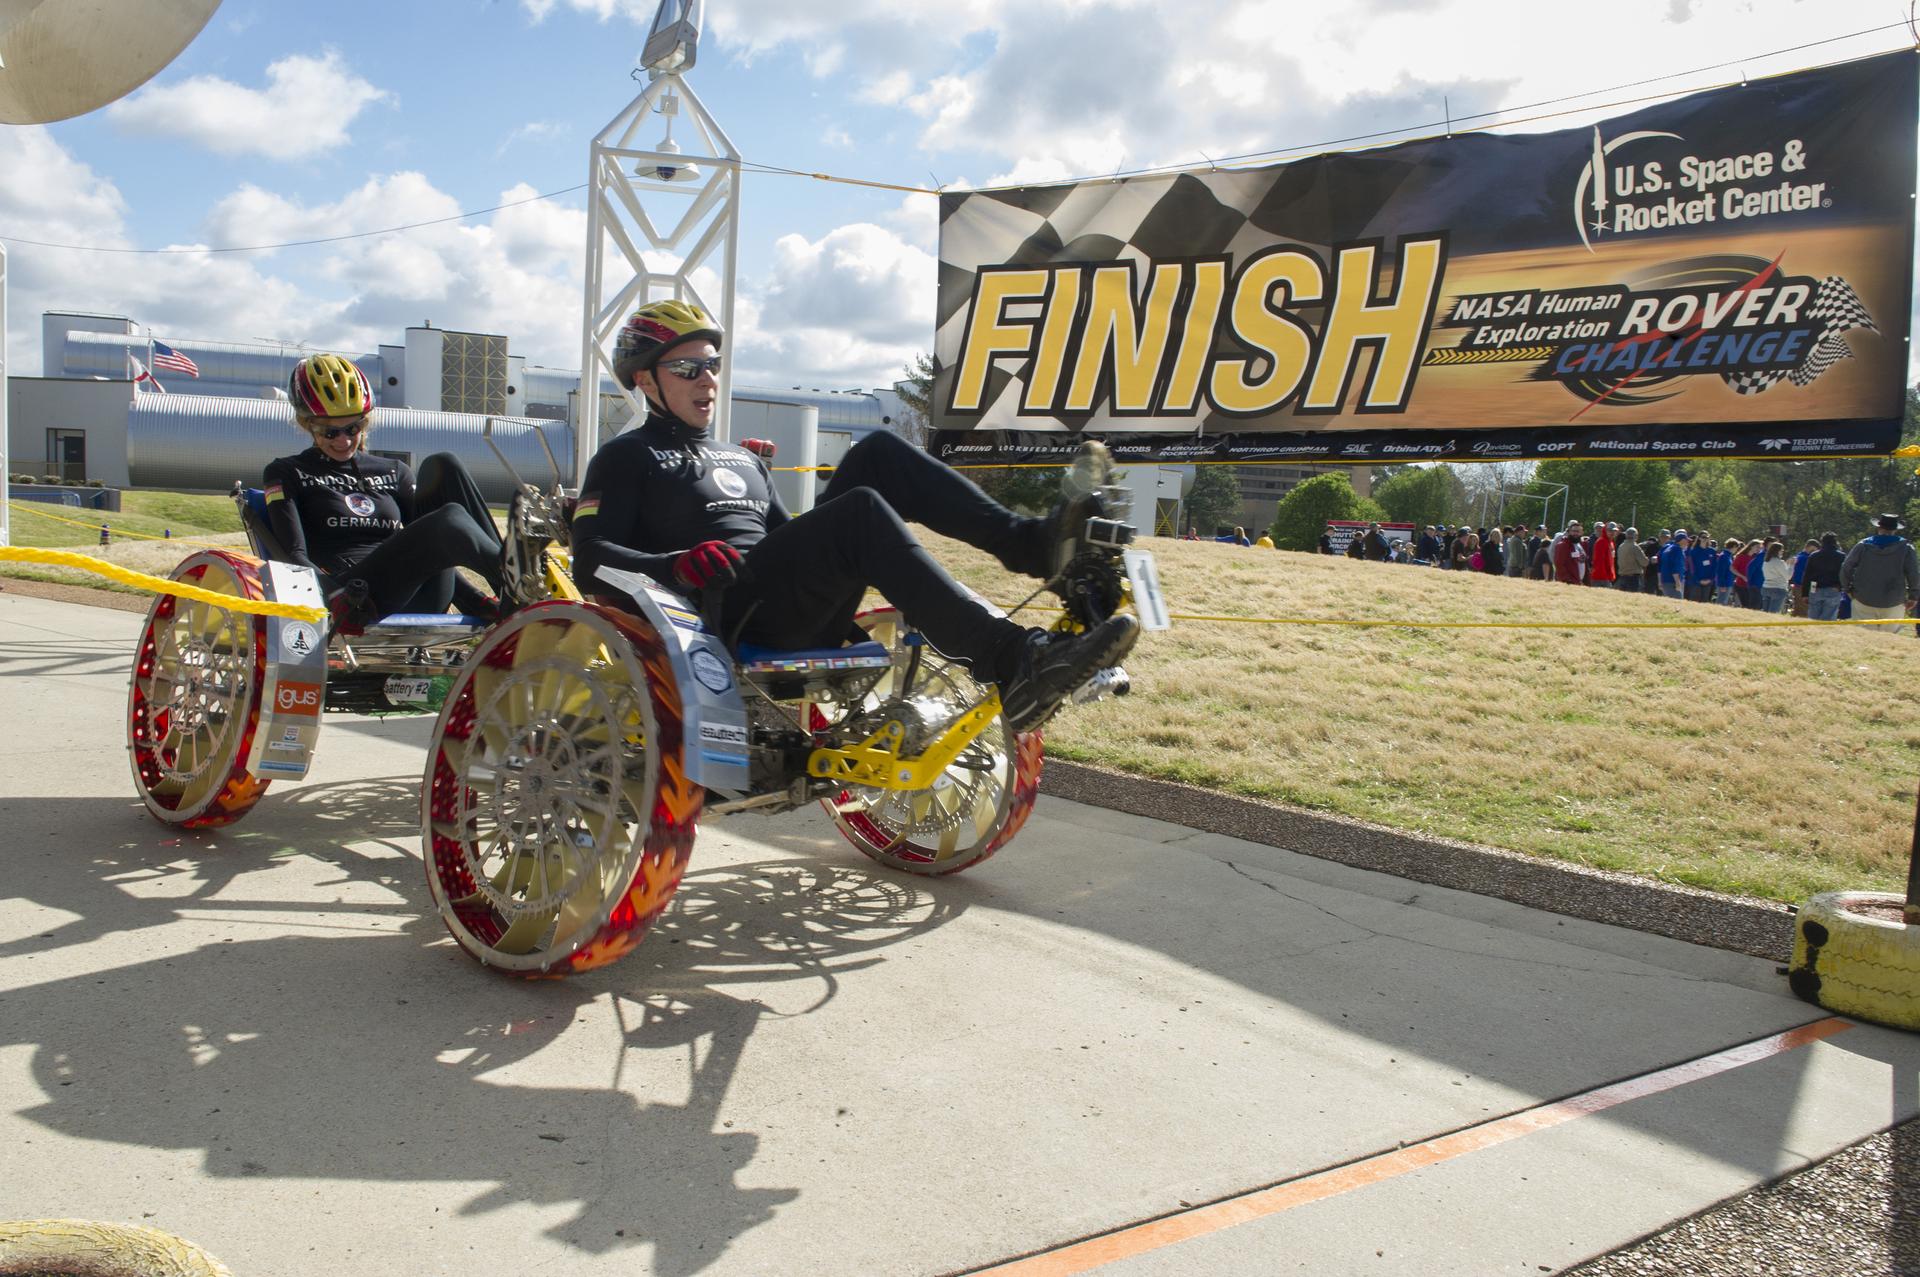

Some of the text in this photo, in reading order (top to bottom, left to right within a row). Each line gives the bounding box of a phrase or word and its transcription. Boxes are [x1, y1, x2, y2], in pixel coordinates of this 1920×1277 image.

[1615, 138, 1807, 197] U.S. Space &
[1613, 193, 1716, 233] Rocket
[1452, 292, 1623, 321] NASA Human
[1617, 283, 1812, 336] ROVER
[950, 237, 1444, 416] FINISH
[1473, 317, 1609, 347] Exploration
[1555, 329, 1810, 375] CHALLENGE
[999, 444, 1048, 453] LOCKHEED
[1114, 445, 1152, 453] JACOBS
[1382, 444, 1443, 453] Orbital ATK
[1537, 442, 1576, 451] COPT
[1589, 440, 1737, 451] National Space Club
[1792, 438, 1837, 446] TELEDYNE
[1822, 443, 1876, 451] ENGINEERING
[327, 516, 399, 529] GERMANY
[415, 681, 430, 695] #2
[278, 685, 318, 709] igus
